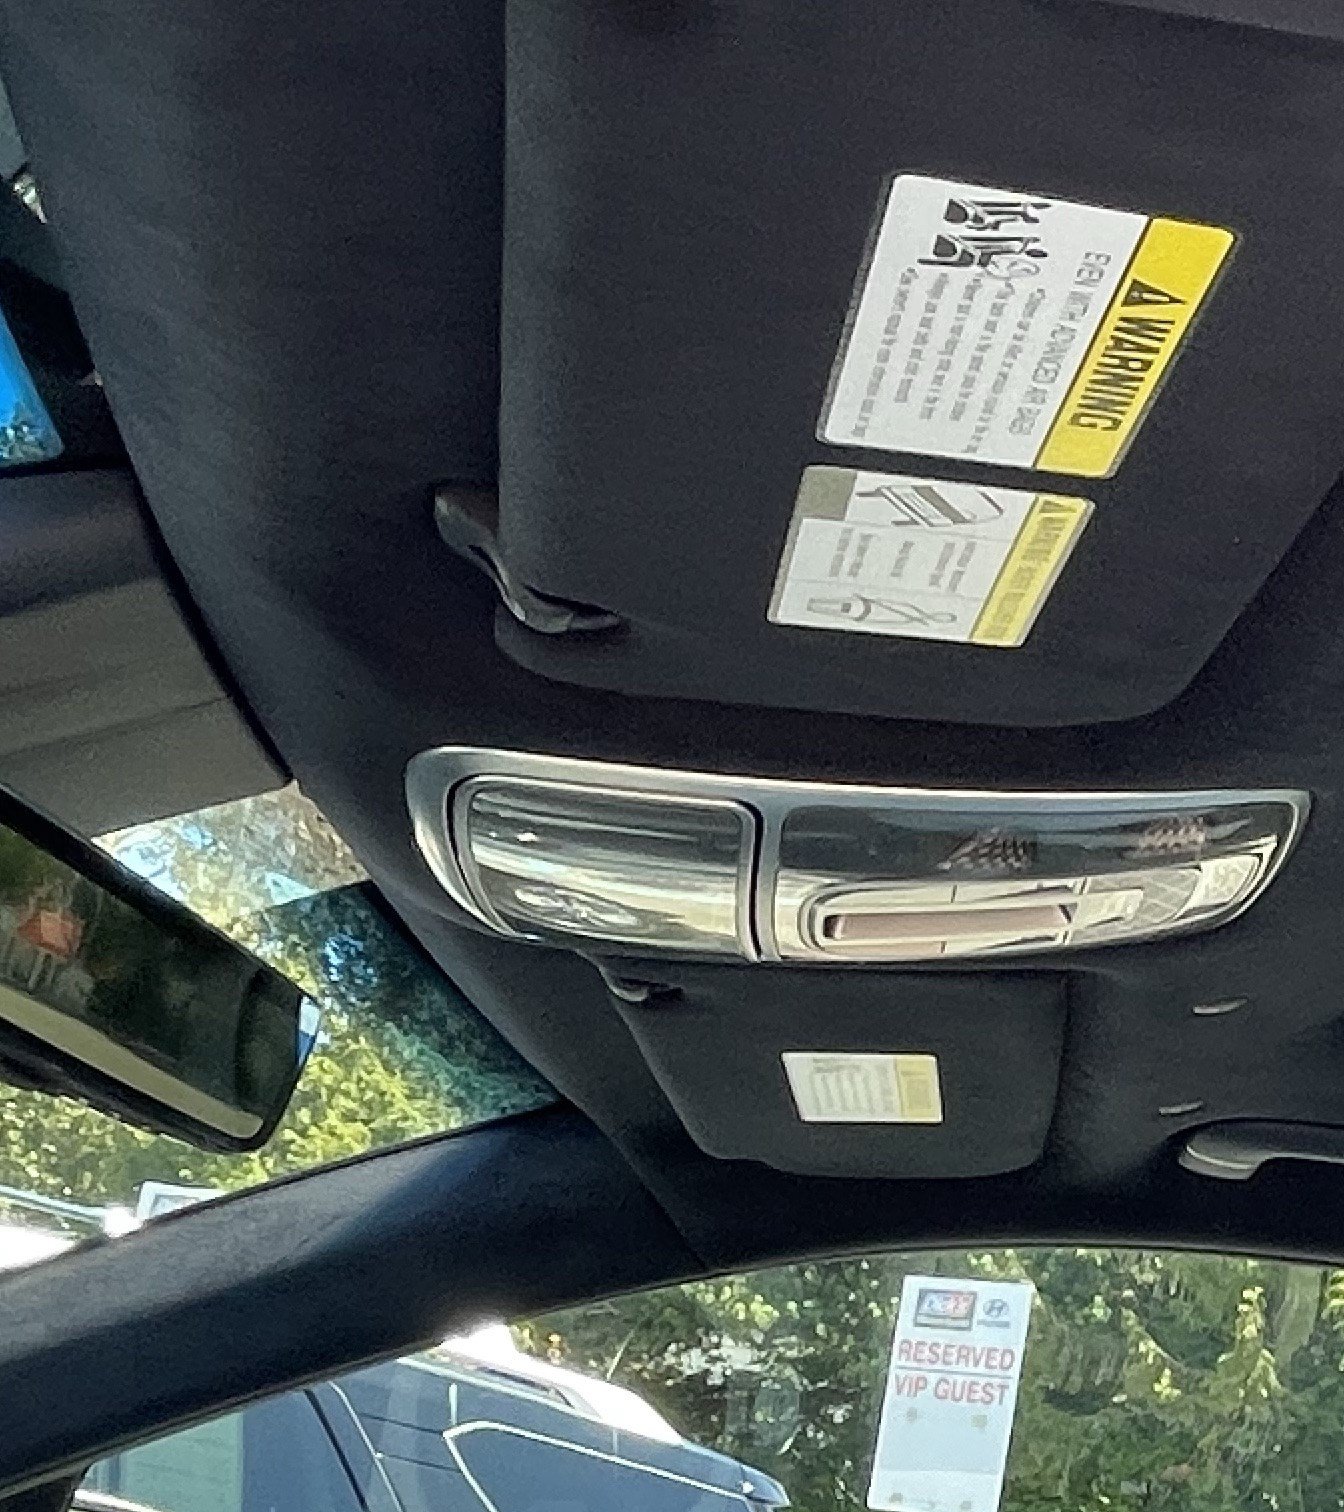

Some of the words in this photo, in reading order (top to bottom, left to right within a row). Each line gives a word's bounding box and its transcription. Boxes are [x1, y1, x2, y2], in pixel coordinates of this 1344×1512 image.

[1075, 252, 1112, 287] EVEN
[1059, 289, 1093, 321] WITH
[1032, 323, 1077, 384] ADVANCED
[1067, 316, 1176, 431] WARNING
[1023, 386, 1047, 404] AIR
[898, 1338, 1016, 1371] RESERVED
[895, 1373, 928, 1398] VIP
[934, 1377, 1010, 1406] GUEST
